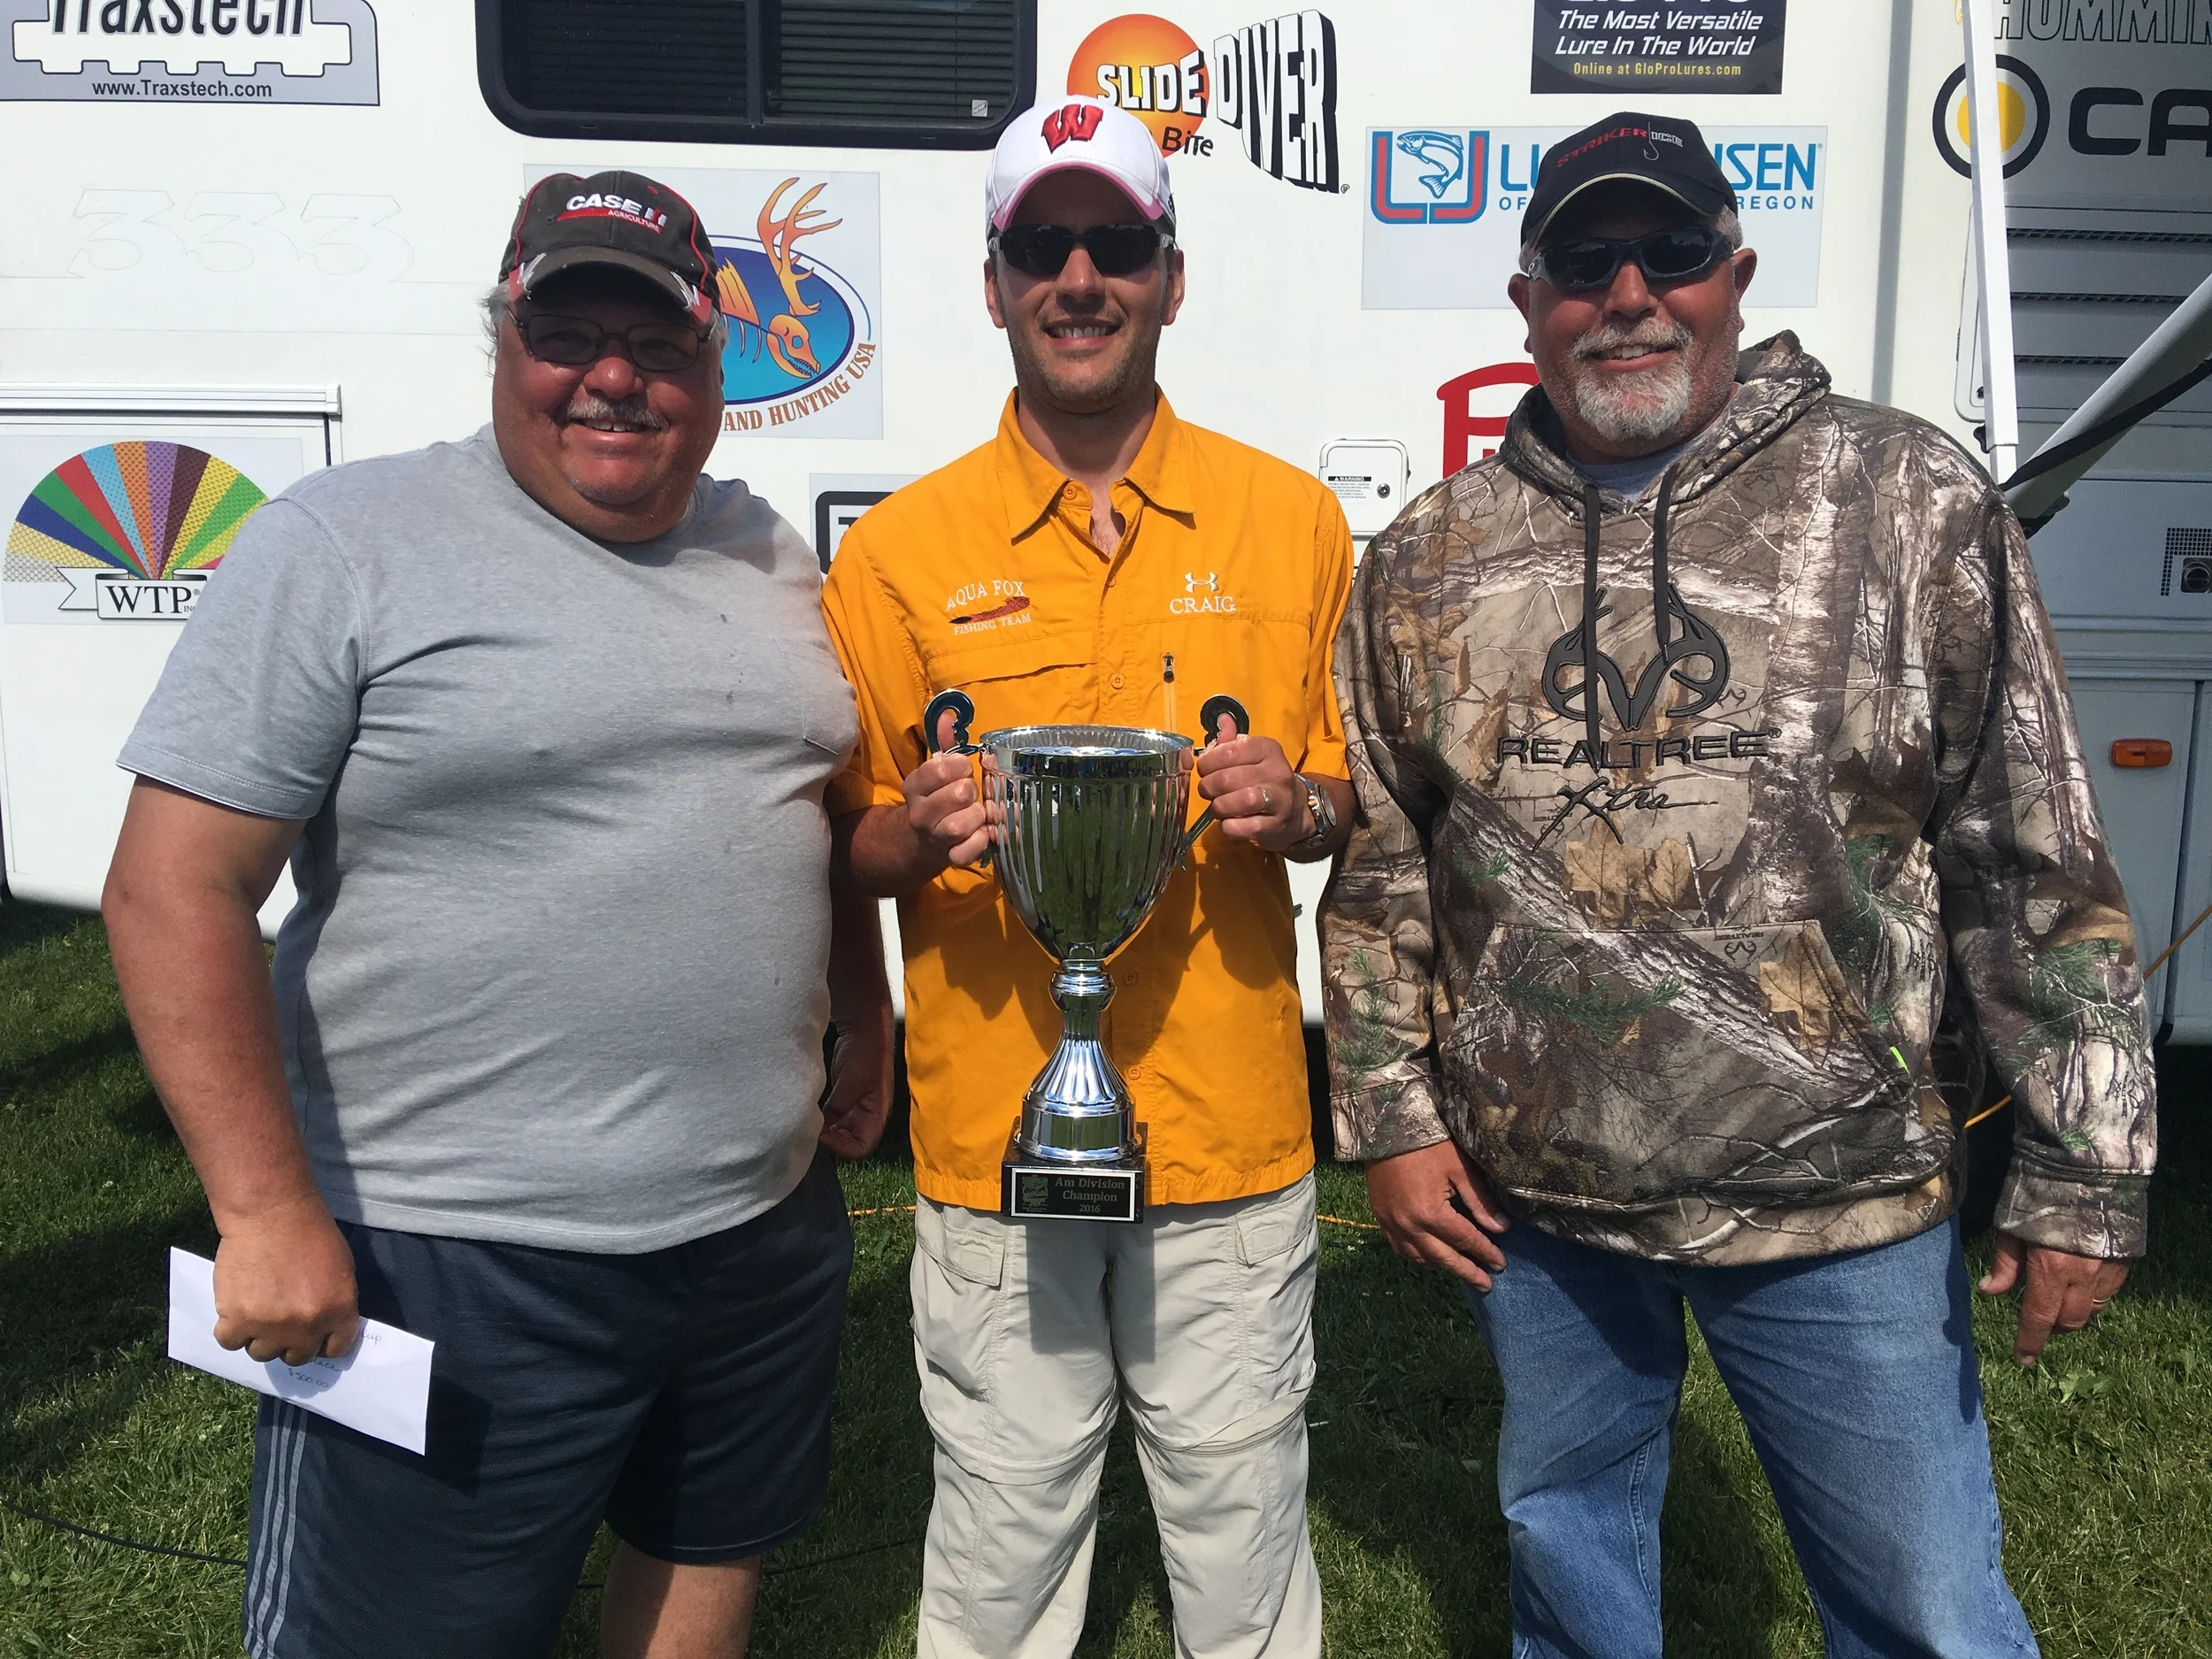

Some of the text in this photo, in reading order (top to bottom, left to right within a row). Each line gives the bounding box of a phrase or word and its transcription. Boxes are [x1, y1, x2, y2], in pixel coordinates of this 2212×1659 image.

[1559, 10, 1763, 30] The Most Versatile
[1555, 35, 1756, 56] Lure In The World
[1574, 62, 1741, 75] Online at GloProLures.com
[92, 80, 273, 97] www.Traxstech.com
[1096, 9, 1340, 194] SLIDE DIVER
[1041, 104, 1104, 154] W
[1557, 127, 1683, 167] STRIKER ICE
[566, 194, 642, 215] CASE
[608, 210, 661, 233] AGRICULTURE
[724, 342, 876, 432] AND HUNTING USA
[105, 586, 192, 613] WTP
[946, 580, 1026, 612] AQUA FOX
[1170, 596, 1236, 614] CRAIG
[953, 613, 1032, 635] FISHING TEAM
[1496, 730, 1770, 769] REALTREE
[1055, 1178, 1125, 1190] Am Division
[1063, 1190, 1118, 1203] Champion
[1079, 1204, 1101, 1213] 2016
